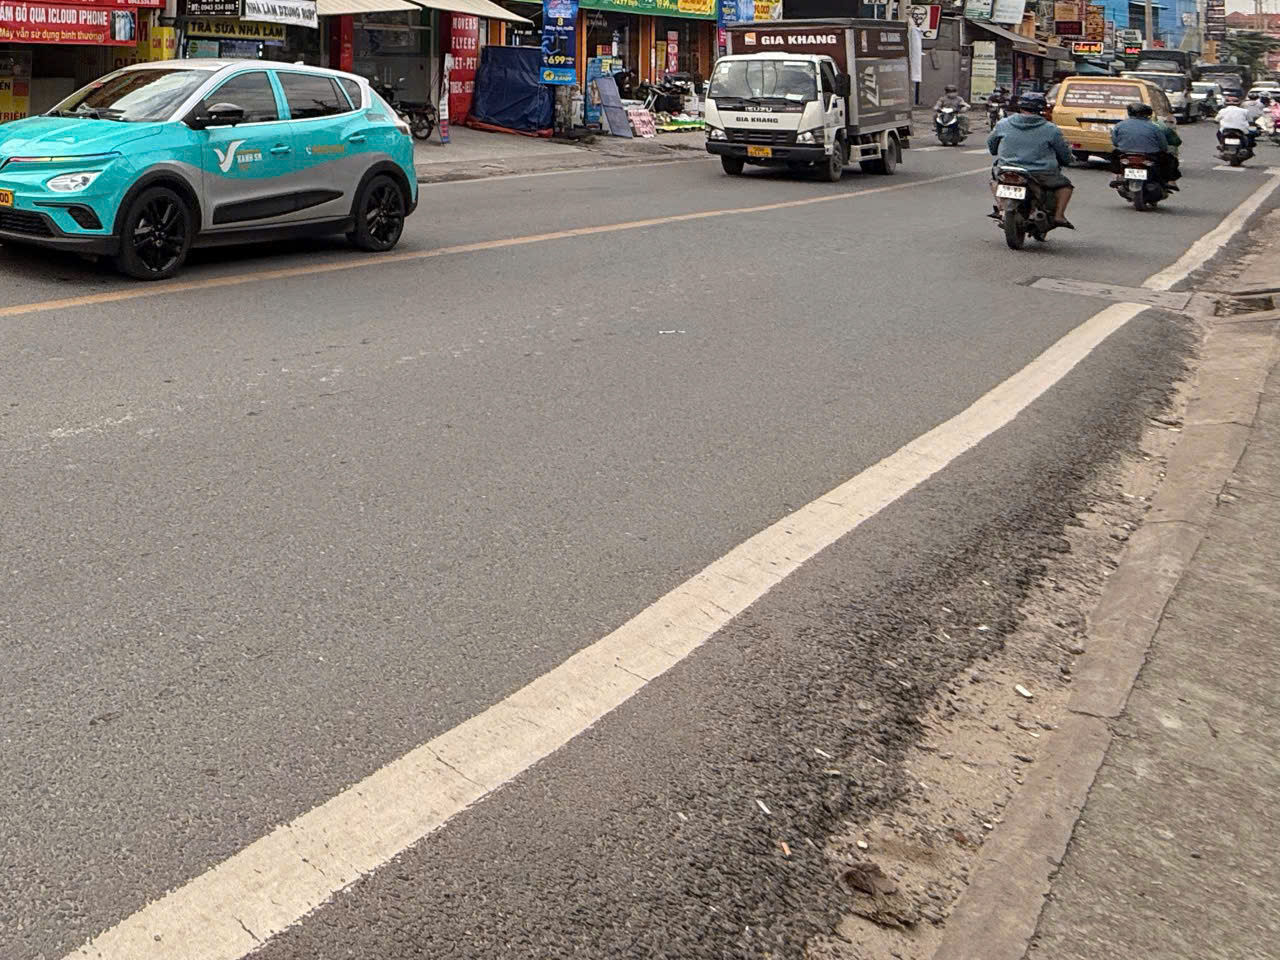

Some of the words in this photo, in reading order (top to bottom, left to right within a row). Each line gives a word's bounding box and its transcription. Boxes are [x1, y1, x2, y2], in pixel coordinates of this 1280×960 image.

[30, 7, 46, 24] QUA
[48, 8, 77, 24] ICLOUD
[79, 10, 108, 26] IPHONE
[452, 17, 478, 30] MOVERS
[452, 36, 476, 49] FLYERS
[761, 35, 784, 46] GIA
[788, 34, 837, 45] KHANG
